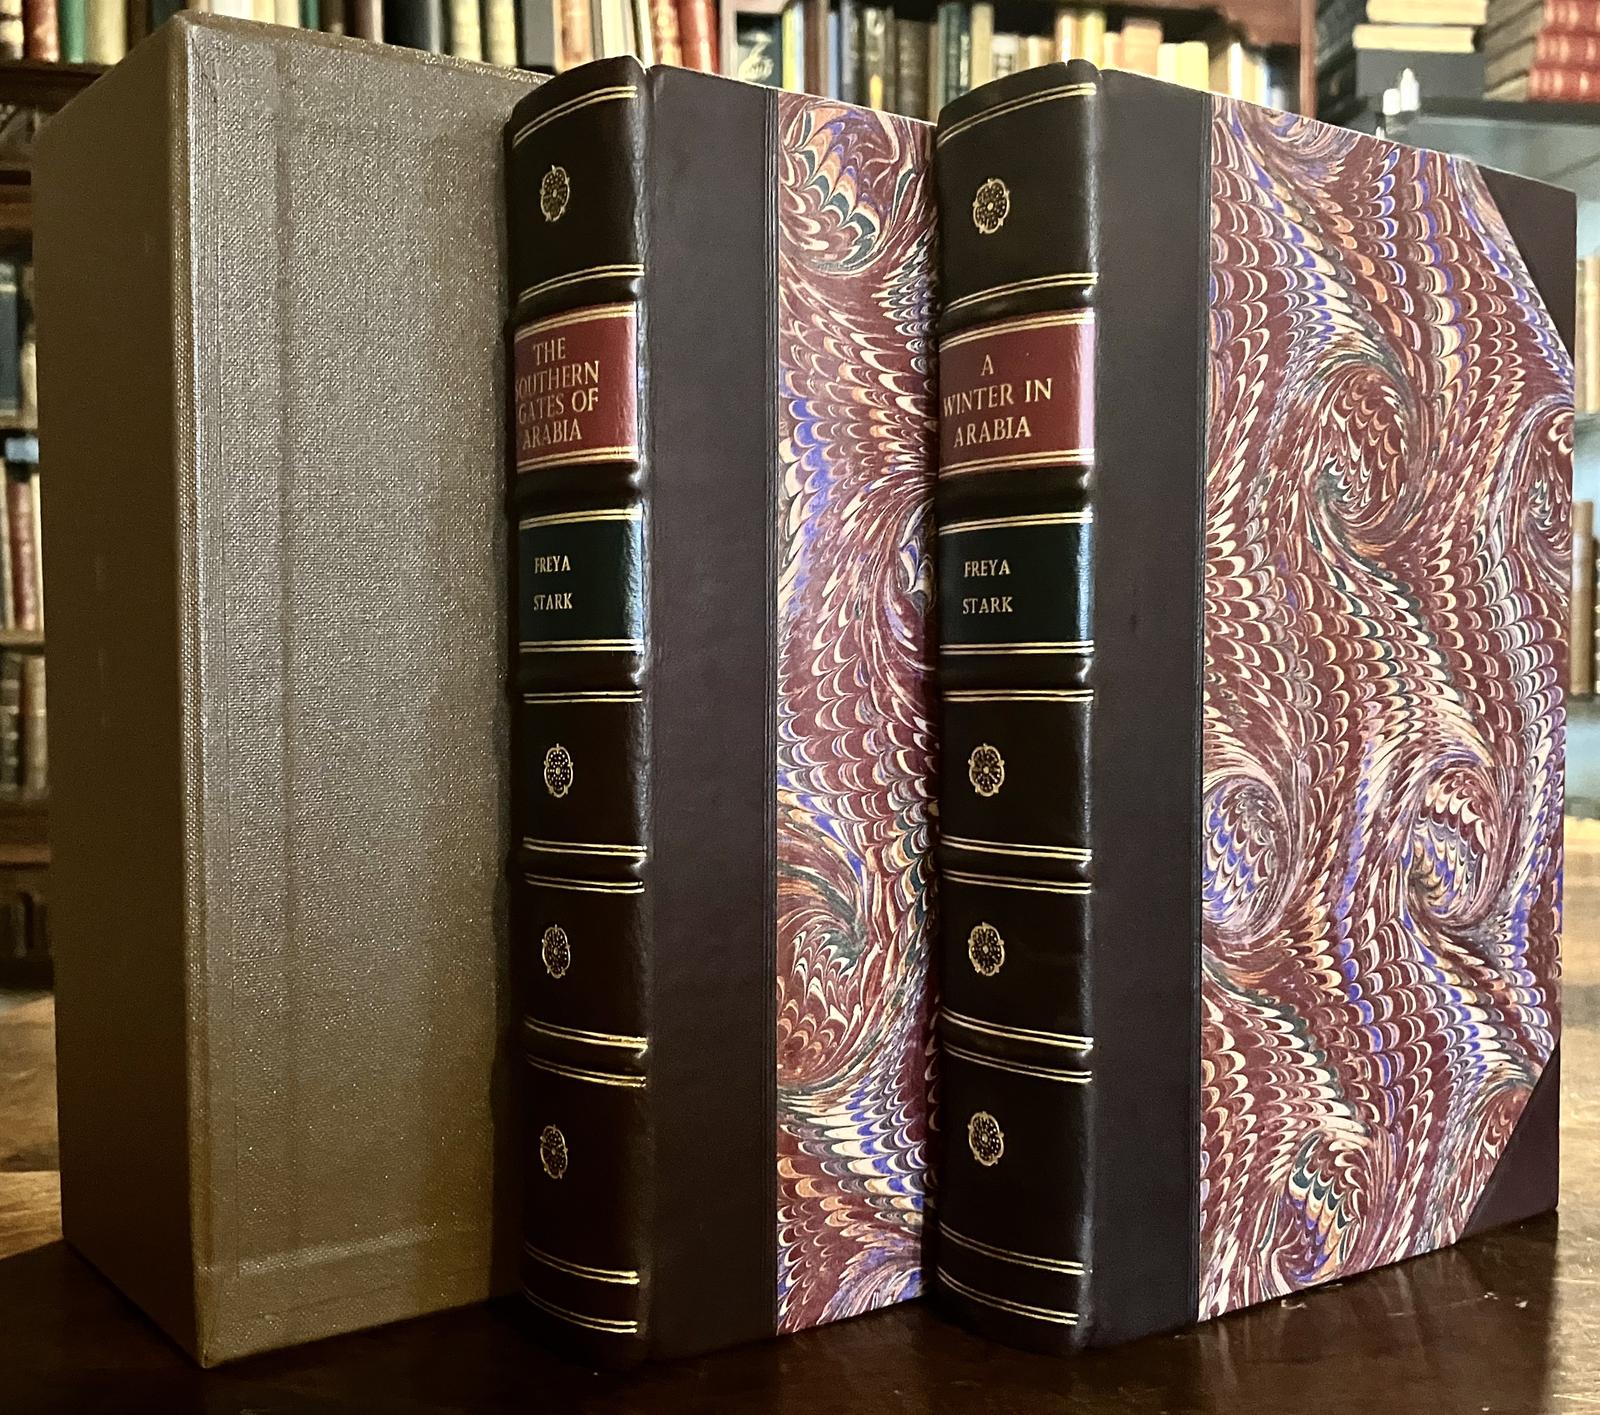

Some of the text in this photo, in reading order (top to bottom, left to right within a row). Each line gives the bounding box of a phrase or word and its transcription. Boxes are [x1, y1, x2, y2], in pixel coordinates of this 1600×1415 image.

[533, 337, 566, 366] THE
[980, 354, 994, 376] A
[518, 387, 599, 425] GATES OF
[943, 377, 1053, 417] WINTER IN
[522, 418, 583, 450] ARABIA
[953, 416, 1032, 448] ARABIA
[534, 555, 571, 574] FREYA
[964, 559, 1011, 578] FREYA
[533, 592, 573, 611] STARK
[962, 596, 1014, 615] STARK
